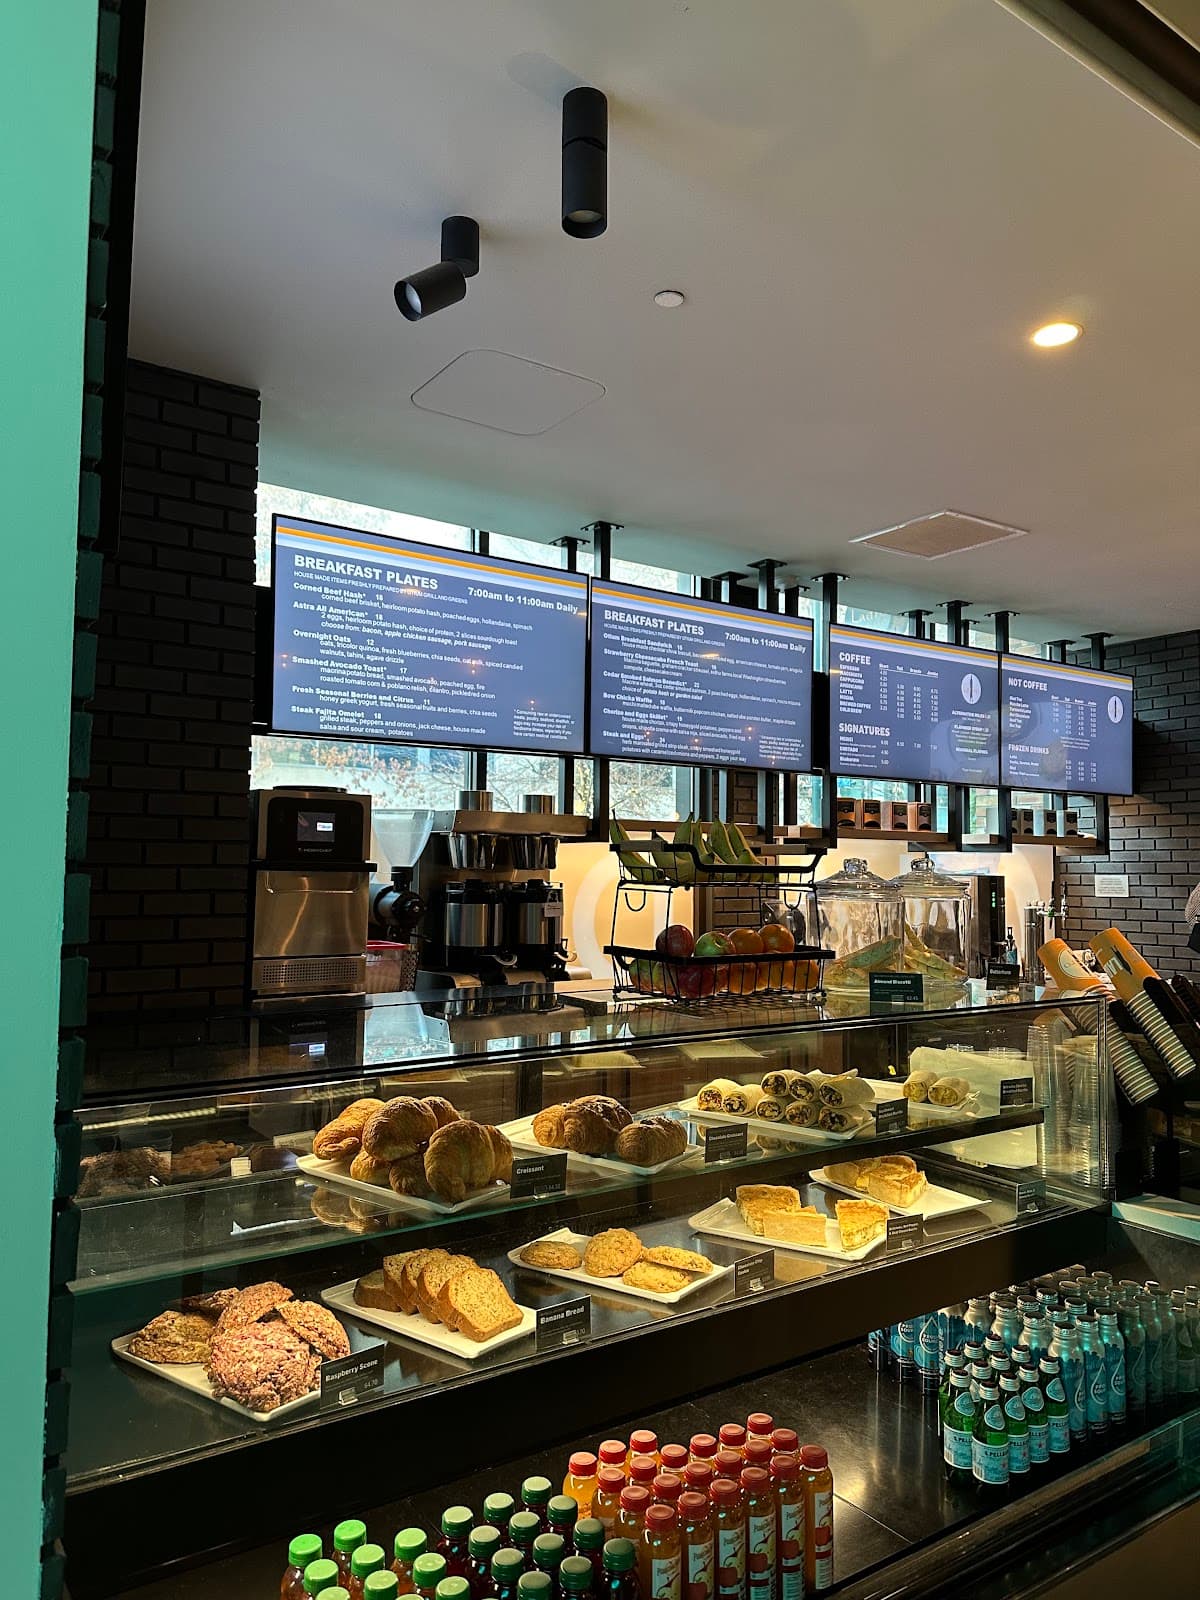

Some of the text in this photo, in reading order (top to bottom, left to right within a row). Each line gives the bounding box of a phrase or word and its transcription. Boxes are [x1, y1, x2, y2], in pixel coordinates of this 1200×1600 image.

[294, 555, 438, 590] BREAKFAST PLATES
[294, 582, 322, 593] Corned
[324, 587, 342, 596] Beef
[294, 602, 315, 611] Astra
[317, 605, 328, 613] All
[468, 587, 578, 615] 7:00am to 11:00am Daily
[322, 594, 533, 631] corned beef brisket, heirloom potato hash, poached eggs, hollandaise, spinach
[605, 611, 704, 636] BREAKFAST PLATES
[294, 630, 332, 642] Overnight
[334, 635, 351, 644] Oats
[321, 621, 345, 630] choose
[362, 626, 383, 636] bacon,
[385, 629, 401, 638] apple
[403, 632, 426, 641] chicken
[427, 635, 452, 645] sausage,
[454, 639, 467, 647] pork
[469, 641, 491, 650] sausage
[725, 633, 806, 654] 7:00am to 11:00am Daily
[293, 656, 328, 667] Smashed
[330, 660, 362, 671] Avocado
[840, 652, 871, 665] COFFEE
[1009, 677, 1047, 691] NOT COFFEE
[293, 686, 314, 694] Fresh
[315, 688, 349, 698] Seasonal
[351, 692, 376, 700] Berries
[393, 696, 414, 704] Citrus
[292, 706, 314, 714] Steak
[316, 708, 337, 716] Fajita
[338, 710, 364, 718] Omelet
[839, 723, 890, 737] SIGNATURES
[1009, 744, 1029, 753] FROZEN
[516, 1164, 545, 1175] Croissant
[540, 1305, 585, 1325] Banana Bread
[325, 1359, 378, 1382] Raspberry Scone
